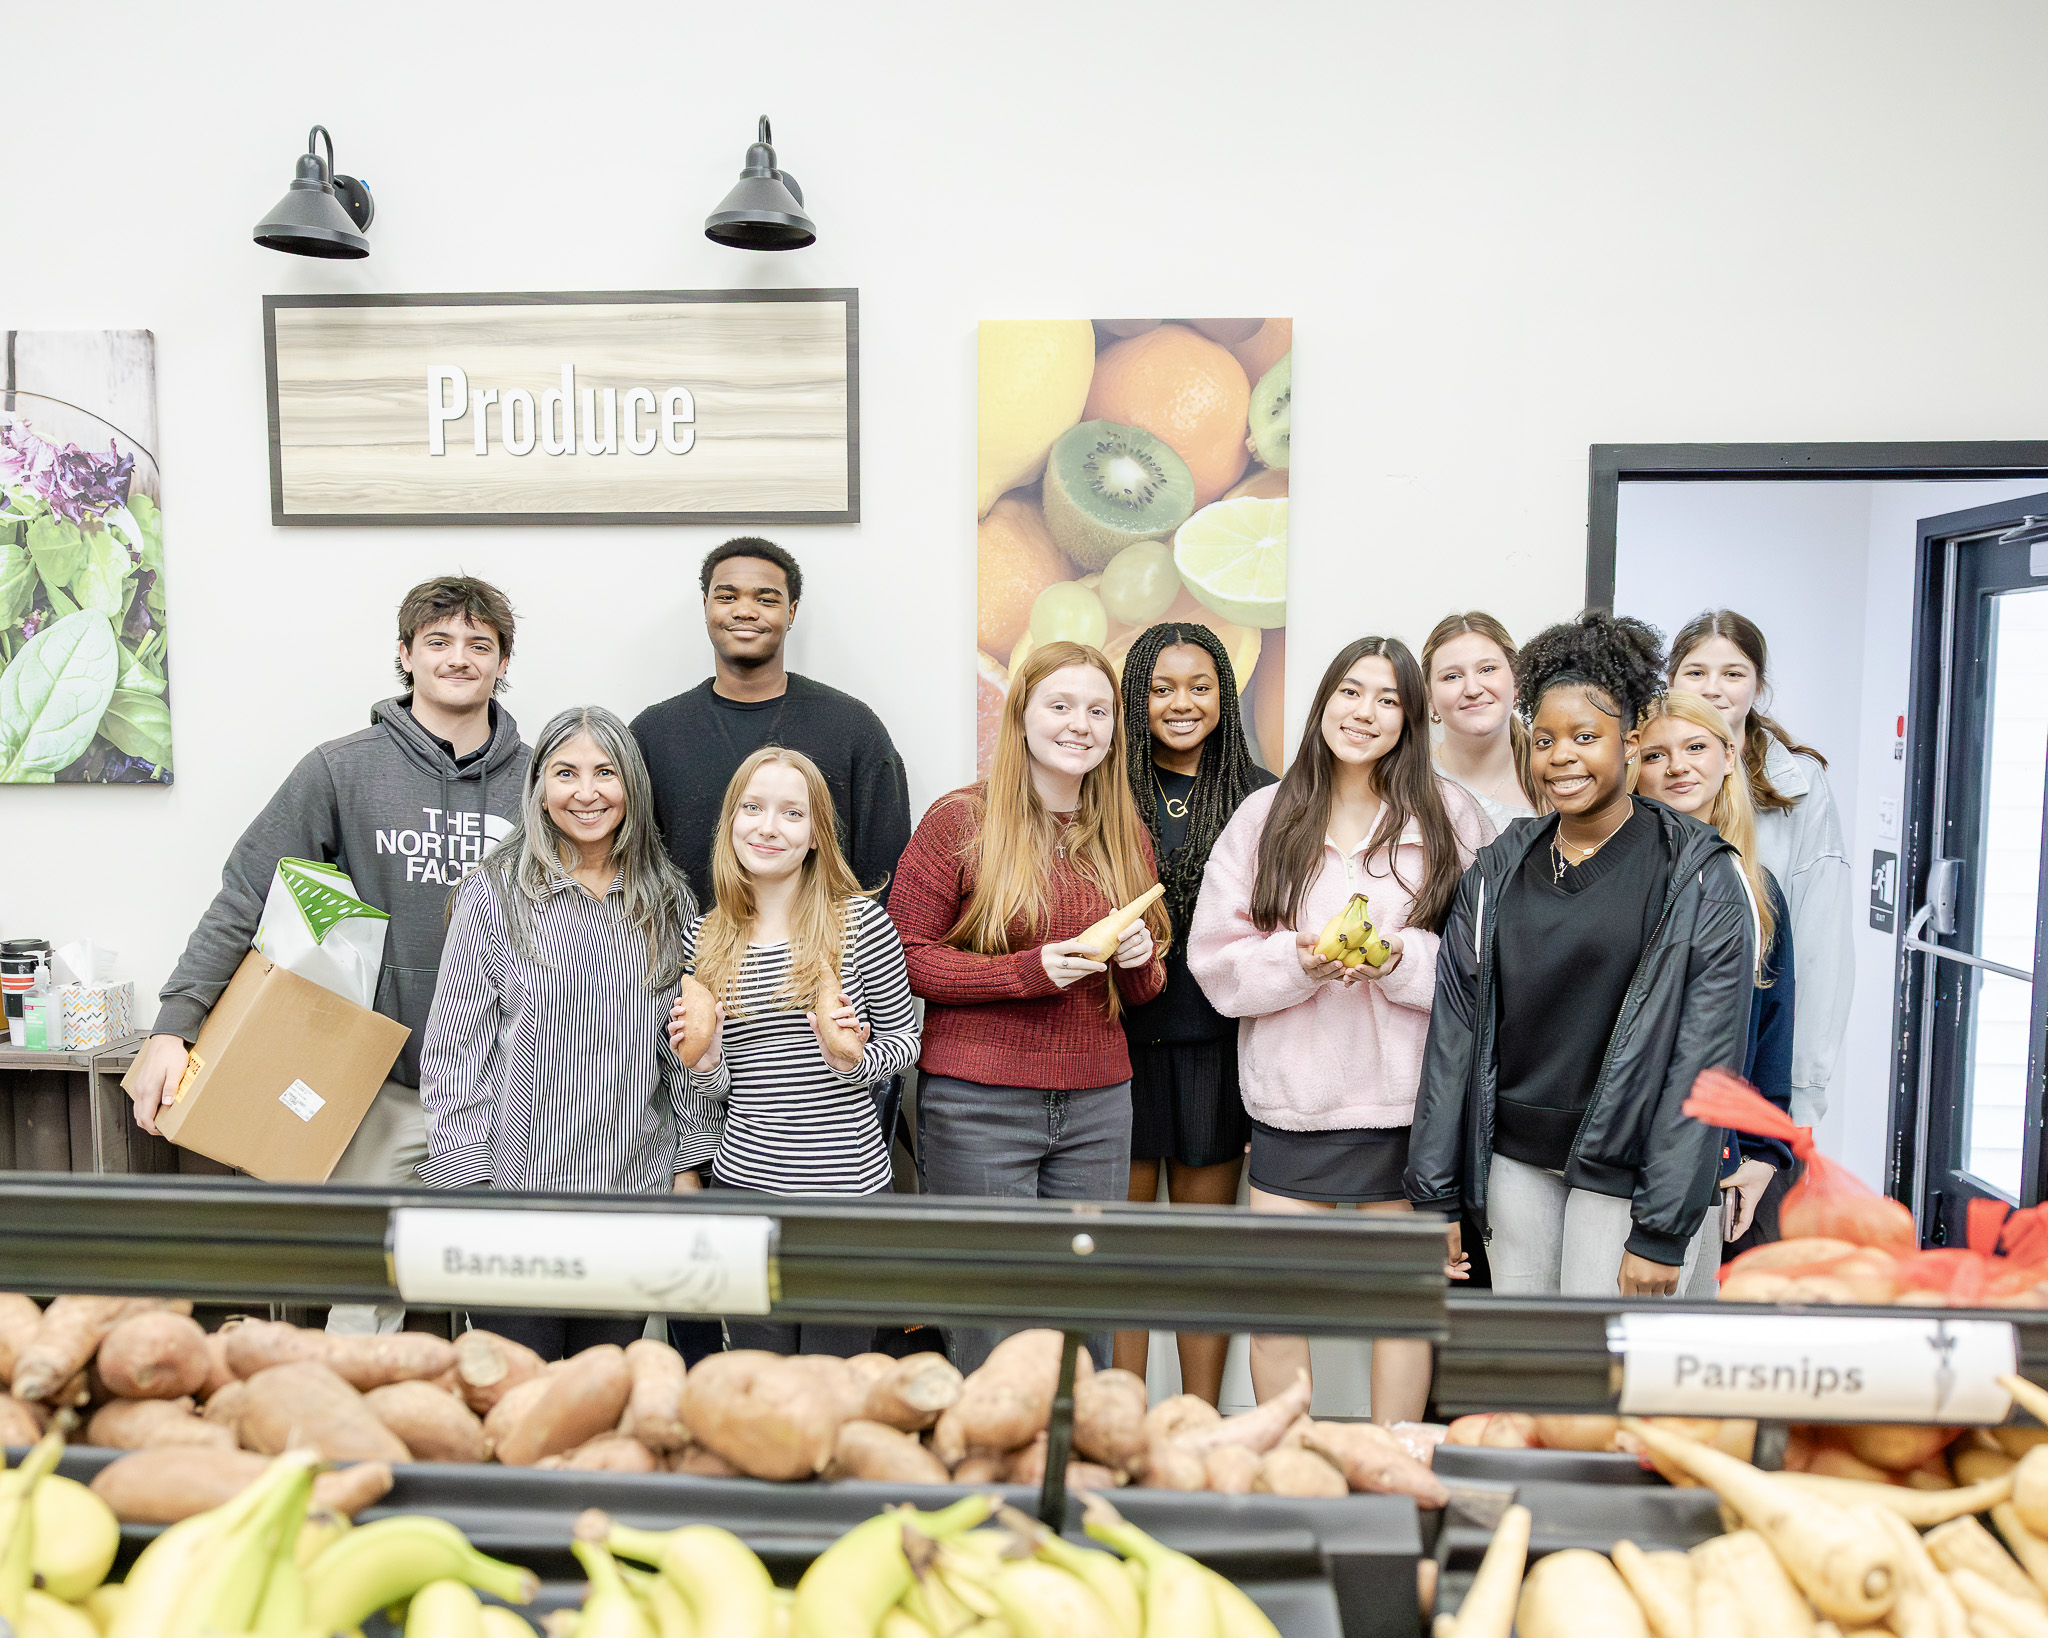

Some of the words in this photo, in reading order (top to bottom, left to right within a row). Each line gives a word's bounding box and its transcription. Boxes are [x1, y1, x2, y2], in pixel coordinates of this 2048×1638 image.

[427, 364, 697, 456] Produce
[422, 807, 481, 837] THE
[375, 829, 480, 861] NORTH
[443, 1246, 587, 1279] Bananas
[1674, 1353, 1864, 1398] Parsnips
